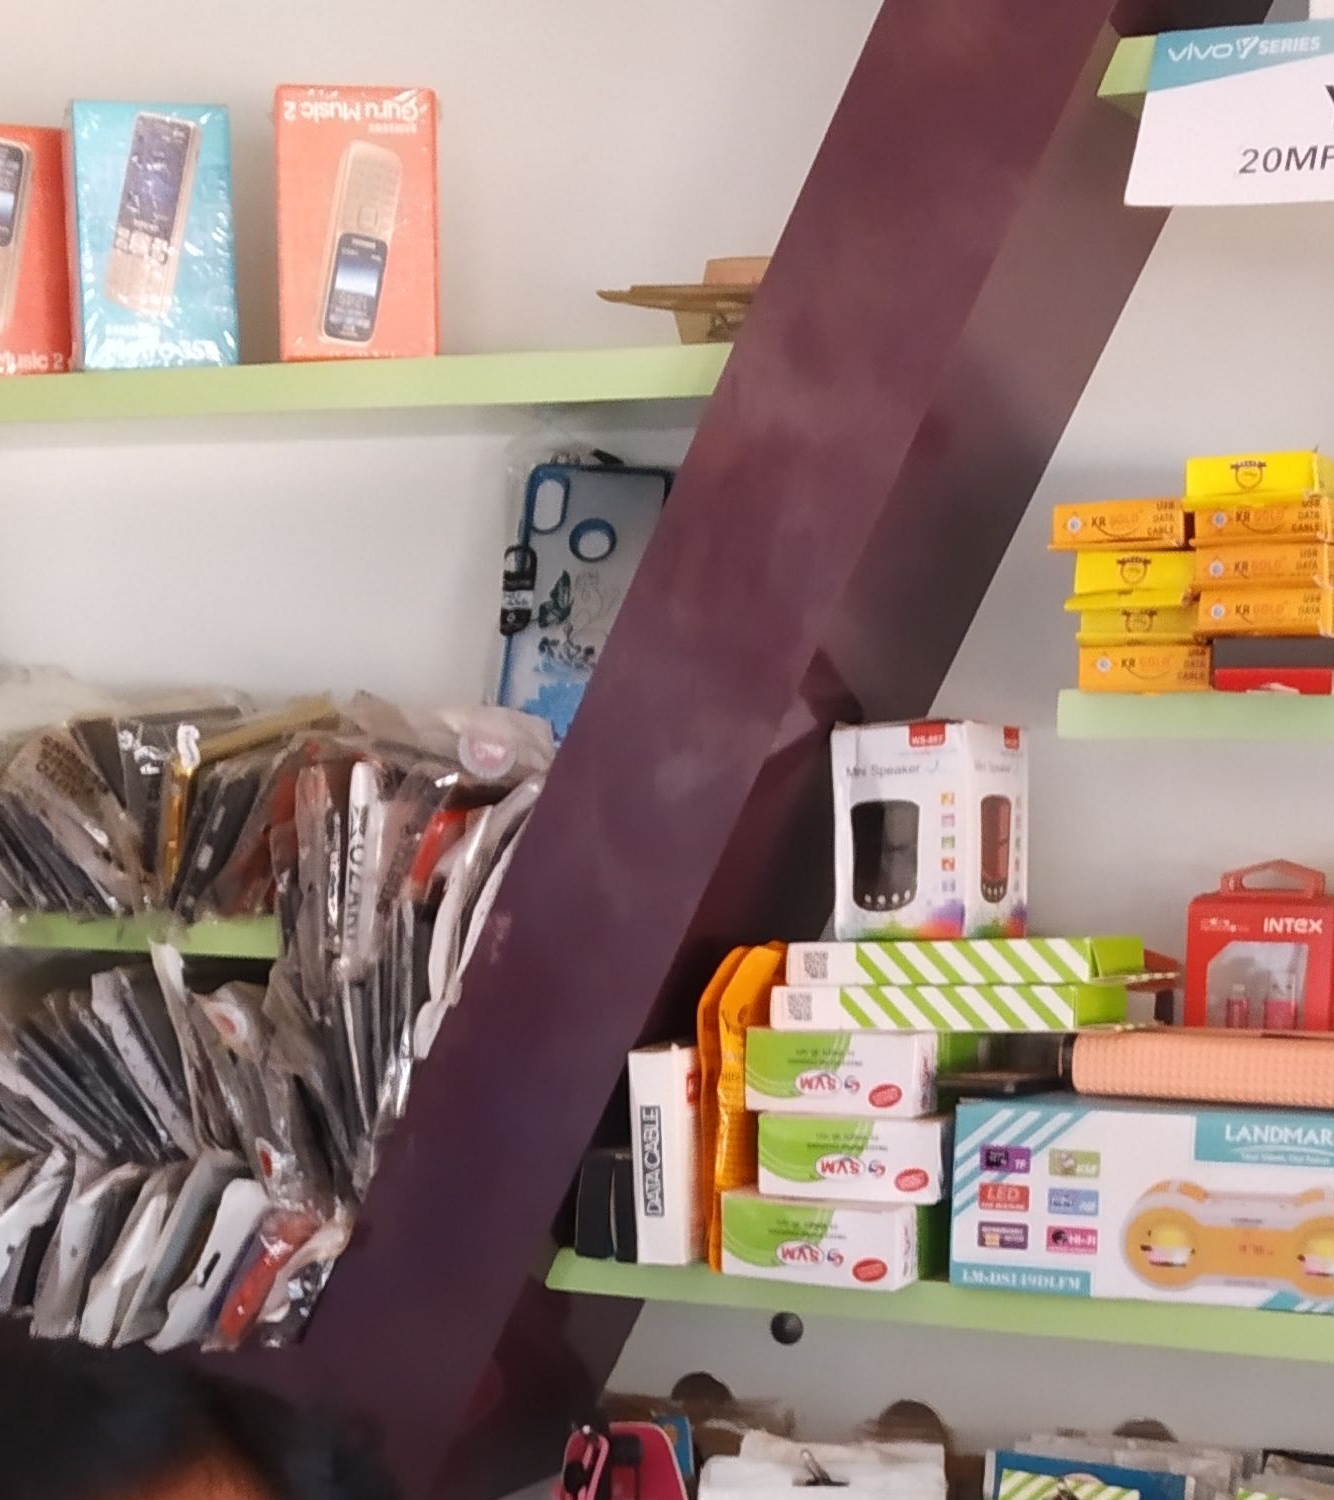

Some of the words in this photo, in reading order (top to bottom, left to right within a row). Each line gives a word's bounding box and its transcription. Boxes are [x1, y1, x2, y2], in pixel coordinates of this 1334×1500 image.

[1168, 42, 1233, 62] vivo
[1258, 35, 1322, 56] SERIES
[283, 101, 296, 122] 2
[301, 100, 360, 123] Music
[1091, 516, 1106, 528] KR
[871, 763, 921, 778] Speaker
[799, 1075, 838, 1092] SVM
[819, 1157, 862, 1176] SVM
[987, 1185, 1019, 1200] LED
[780, 1245, 822, 1263] SVM
